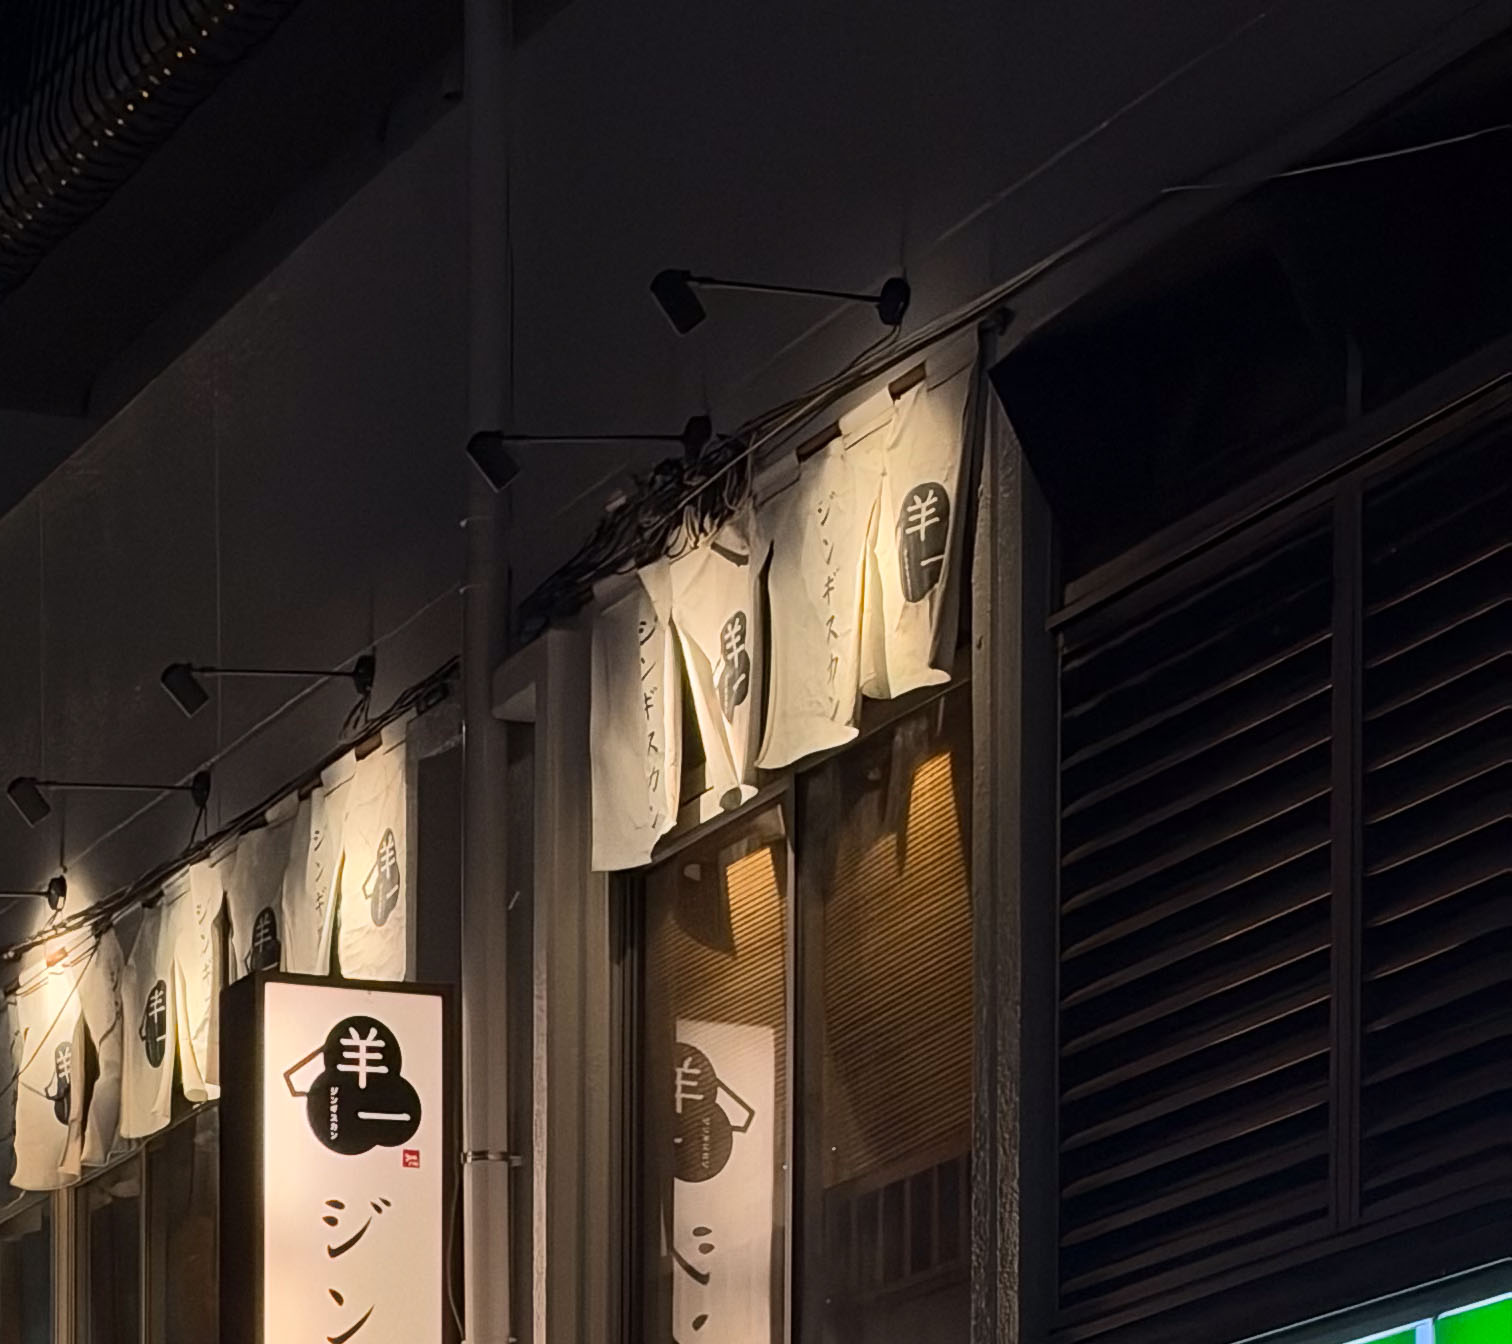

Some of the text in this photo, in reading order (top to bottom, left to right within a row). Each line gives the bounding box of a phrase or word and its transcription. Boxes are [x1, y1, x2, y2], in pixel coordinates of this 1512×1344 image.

[906, 488, 944, 567] 羊一
[817, 491, 842, 722] ジンギスカン
[638, 618, 659, 830] ジンギスカン
[336, 1027, 411, 1121] 羊一
